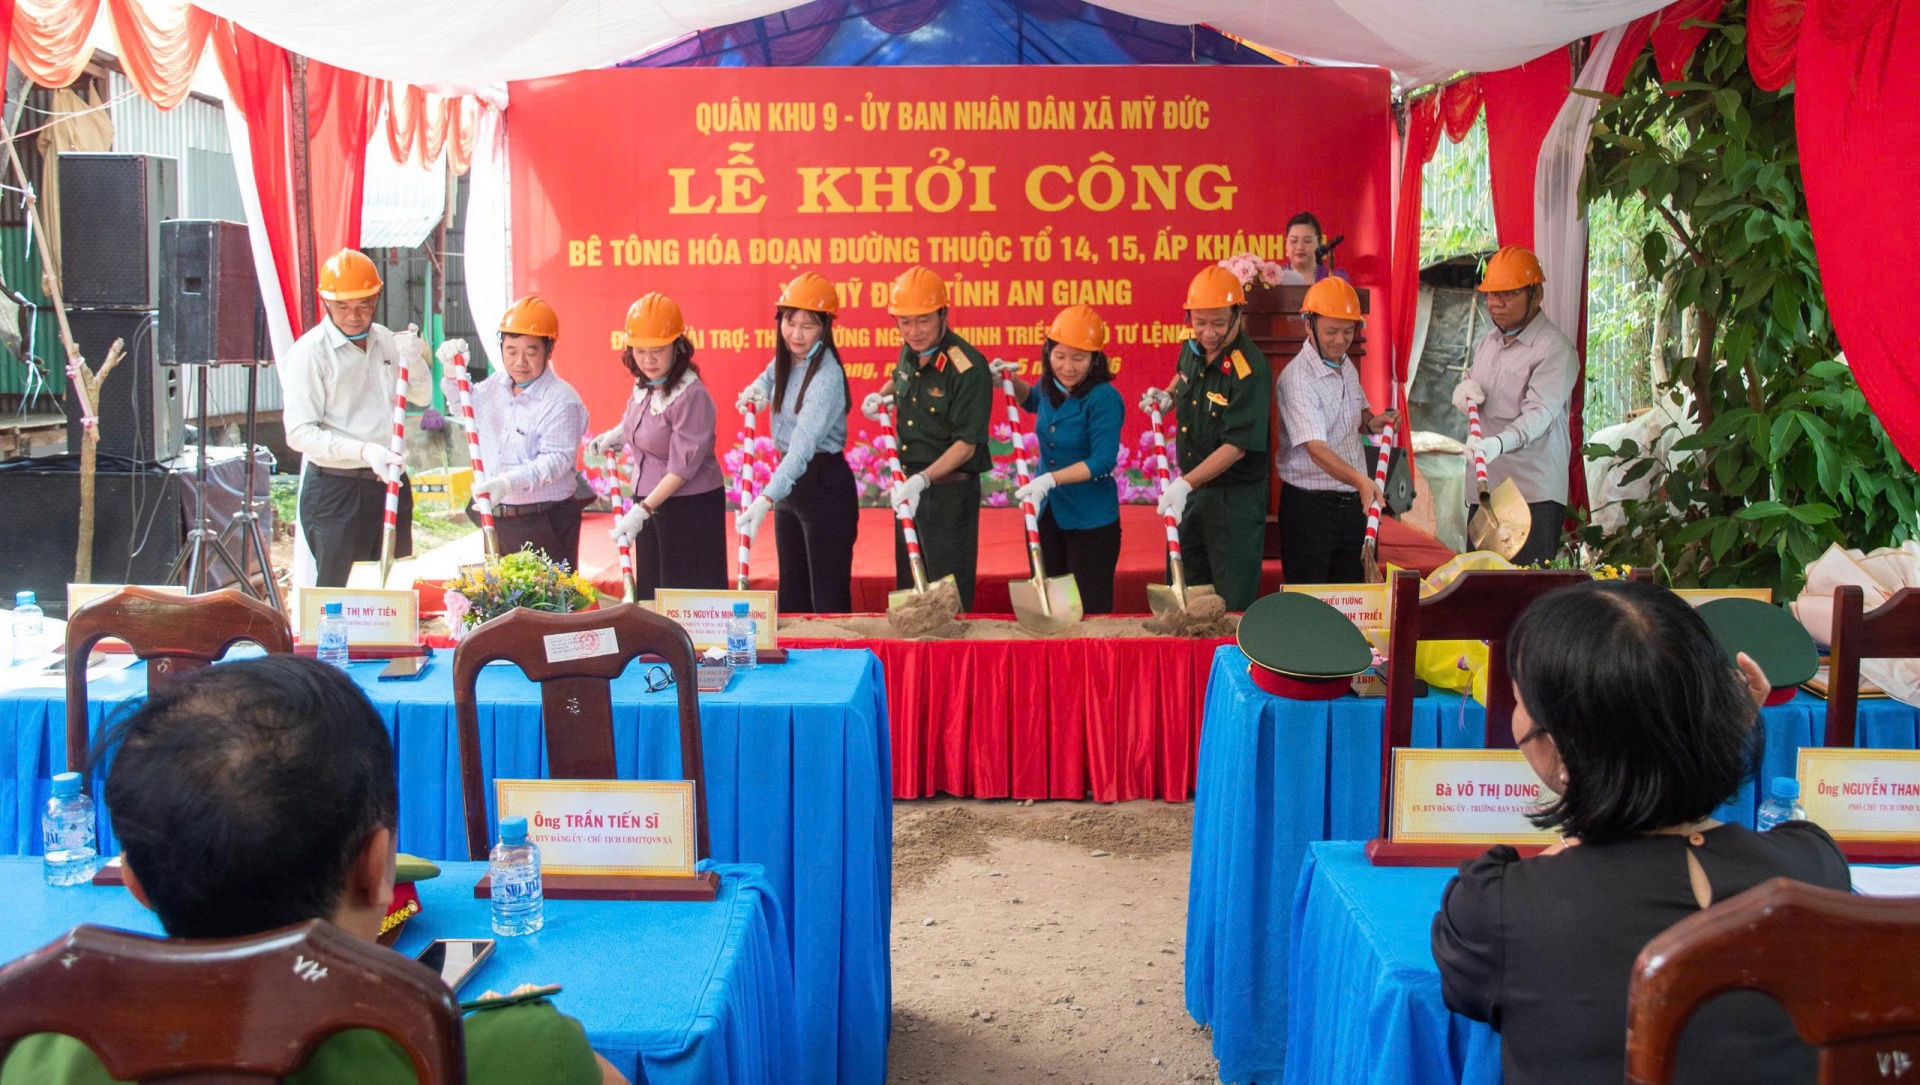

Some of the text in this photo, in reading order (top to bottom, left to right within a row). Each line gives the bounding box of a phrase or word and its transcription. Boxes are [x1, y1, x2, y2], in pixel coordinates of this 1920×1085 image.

[696, 97, 761, 134] QUÂN
[769, 103, 816, 131] KHU
[823, 102, 837, 131] 9
[861, 92, 891, 130] ỦY
[898, 102, 947, 130] BAN
[954, 96, 1020, 130] NHÂN
[1028, 96, 1075, 130] DÂN
[1083, 97, 1114, 130] XÃ
[1121, 97, 1156, 129] MỸ
[1163, 98, 1210, 129] ĐỨC
[668, 142, 1237, 214] LỄ KHỞI CÔNG
[569, 235, 602, 266] BÊ
[611, 235, 679, 265] TÔNG
[688, 234, 741, 264] HÓA
[749, 238, 822, 270] ĐOẠN
[830, 232, 919, 264] ĐƯỜNG
[928, 231, 1012, 269] THUỘC
[1020, 226, 1053, 262] TỔ
[1062, 236, 1098, 264] 14,
[1108, 235, 1146, 264] 15,
[1154, 225, 1188, 261] ẤP
[1196, 229, 1284, 260] KHÁNH
[944, 272, 999, 307] TỈNH
[1007, 280, 1044, 306] AN
[1052, 279, 1133, 305] GIANG
[687, 327, 705, 349] ÀI
[709, 327, 750, 352] TRỢ:
[1115, 323, 1139, 345] TƯ
[346, 606, 360, 618] THỊ
[362, 605, 375, 617] MỸ
[666, 609, 681, 619] PGS.
[683, 610, 692, 619] TS
[693, 606, 719, 619] NGUYỄN
[721, 610, 734, 619] MIN
[1435, 780, 1540, 800] Bà VÕ THỊ DUNG
[1817, 778, 1840, 798] Ông
[1842, 777, 1887, 796] NGUYỄN
[1437, 804, 1455, 812] ĐẢNG
[1879, 803, 1895, 812] TỊCH
[1896, 804, 1915, 812] UBND
[533, 808, 660, 829] Ông TRẦN TIẾN SĨ
[535, 834, 550, 842] BTV
[550, 833, 571, 843] ĐẢNG
[604, 835, 621, 844] TỊCH
